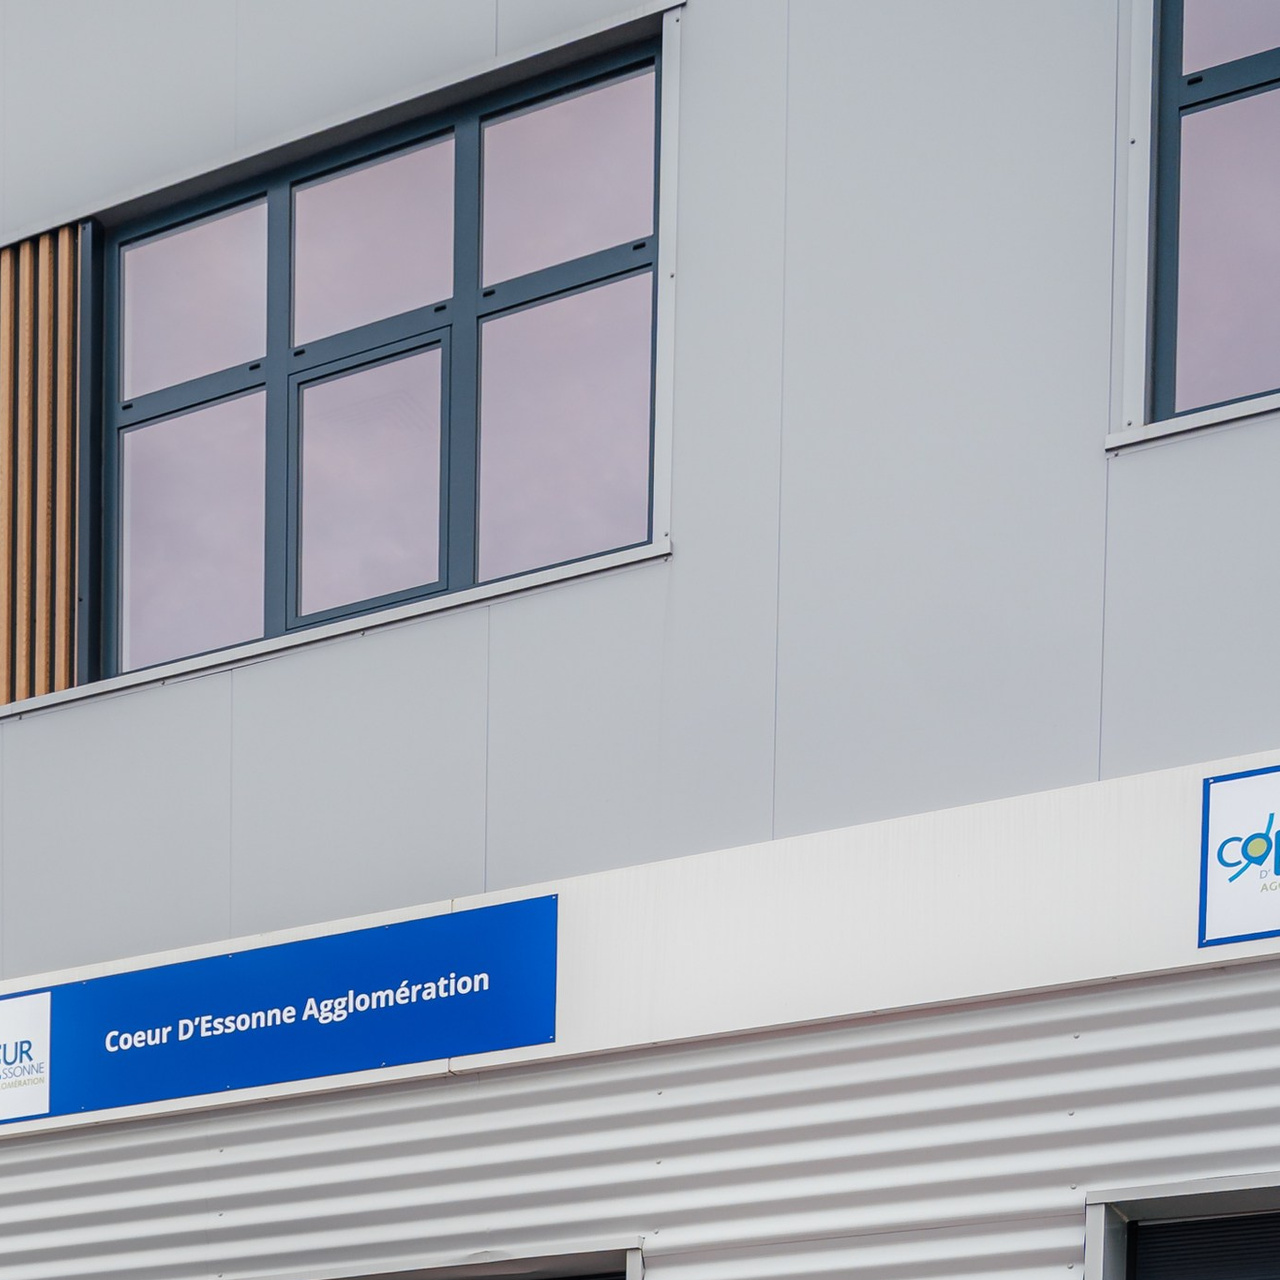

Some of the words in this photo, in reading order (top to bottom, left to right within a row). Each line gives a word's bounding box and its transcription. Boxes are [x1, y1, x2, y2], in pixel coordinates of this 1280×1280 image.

[1261, 880, 1280, 892] AG
[104, 1025, 173, 1054] Coeur
[177, 1004, 297, 1043] D'Essonne
[302, 970, 491, 1025] Agglomération
